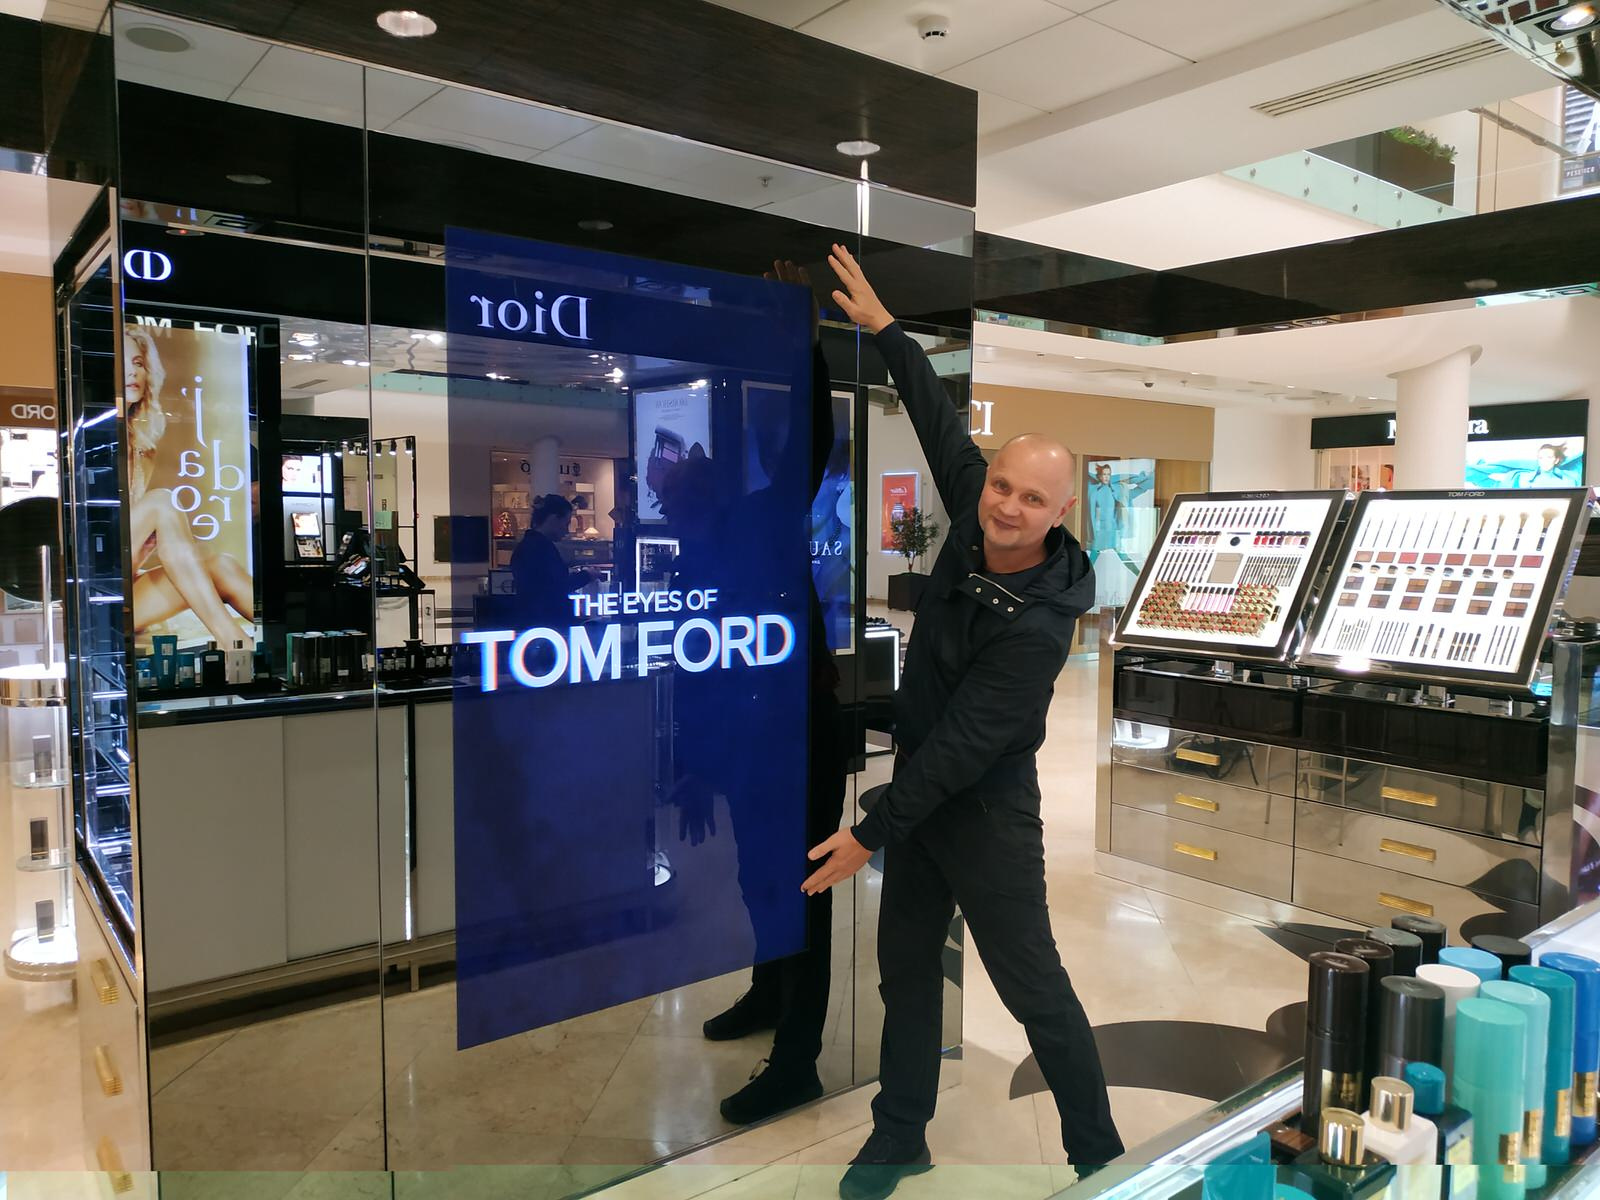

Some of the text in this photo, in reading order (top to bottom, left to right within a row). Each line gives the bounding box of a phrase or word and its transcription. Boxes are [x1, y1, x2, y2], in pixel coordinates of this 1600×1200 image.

[568, 588, 719, 617] THE EYES OF
[460, 613, 797, 693] TOM FORD
